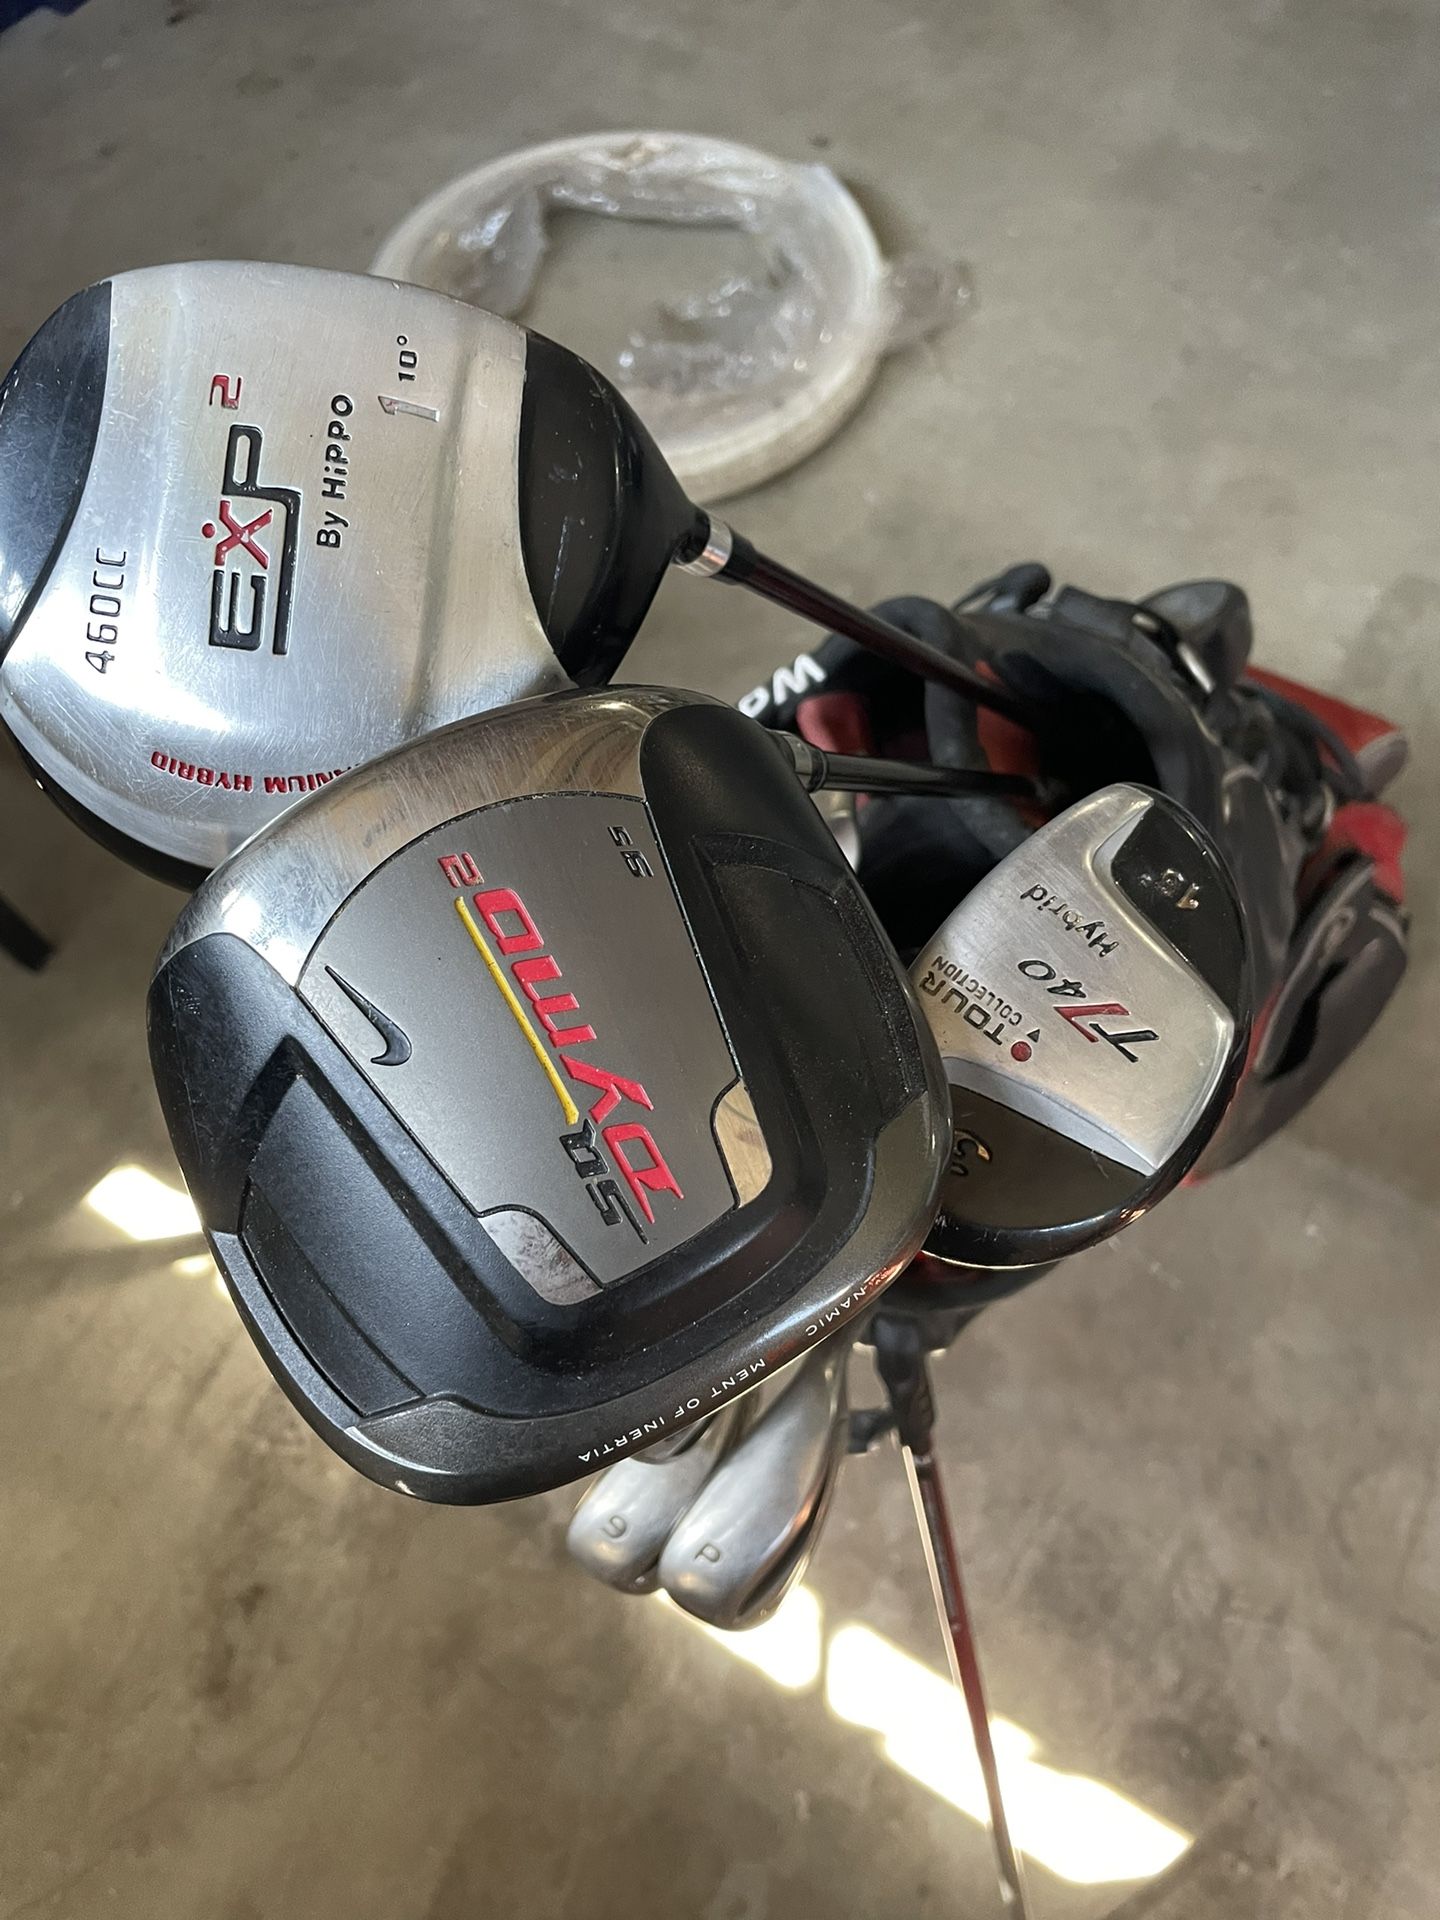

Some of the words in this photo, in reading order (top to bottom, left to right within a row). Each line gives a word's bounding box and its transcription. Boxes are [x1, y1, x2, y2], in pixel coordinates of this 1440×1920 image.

[396, 334, 418, 382] 10°
[316, 511, 349, 549] By
[84, 547, 128, 675] 460CC
[150, 750, 253, 792] HYBRID
[1020, 883, 1120, 958] Hybrid
[918, 970, 1004, 1046] TOUR
[931, 955, 1023, 1027] COLLECTION
[674, 1397, 700, 1419] OF
[576, 1415, 666, 1463] INERTIA
